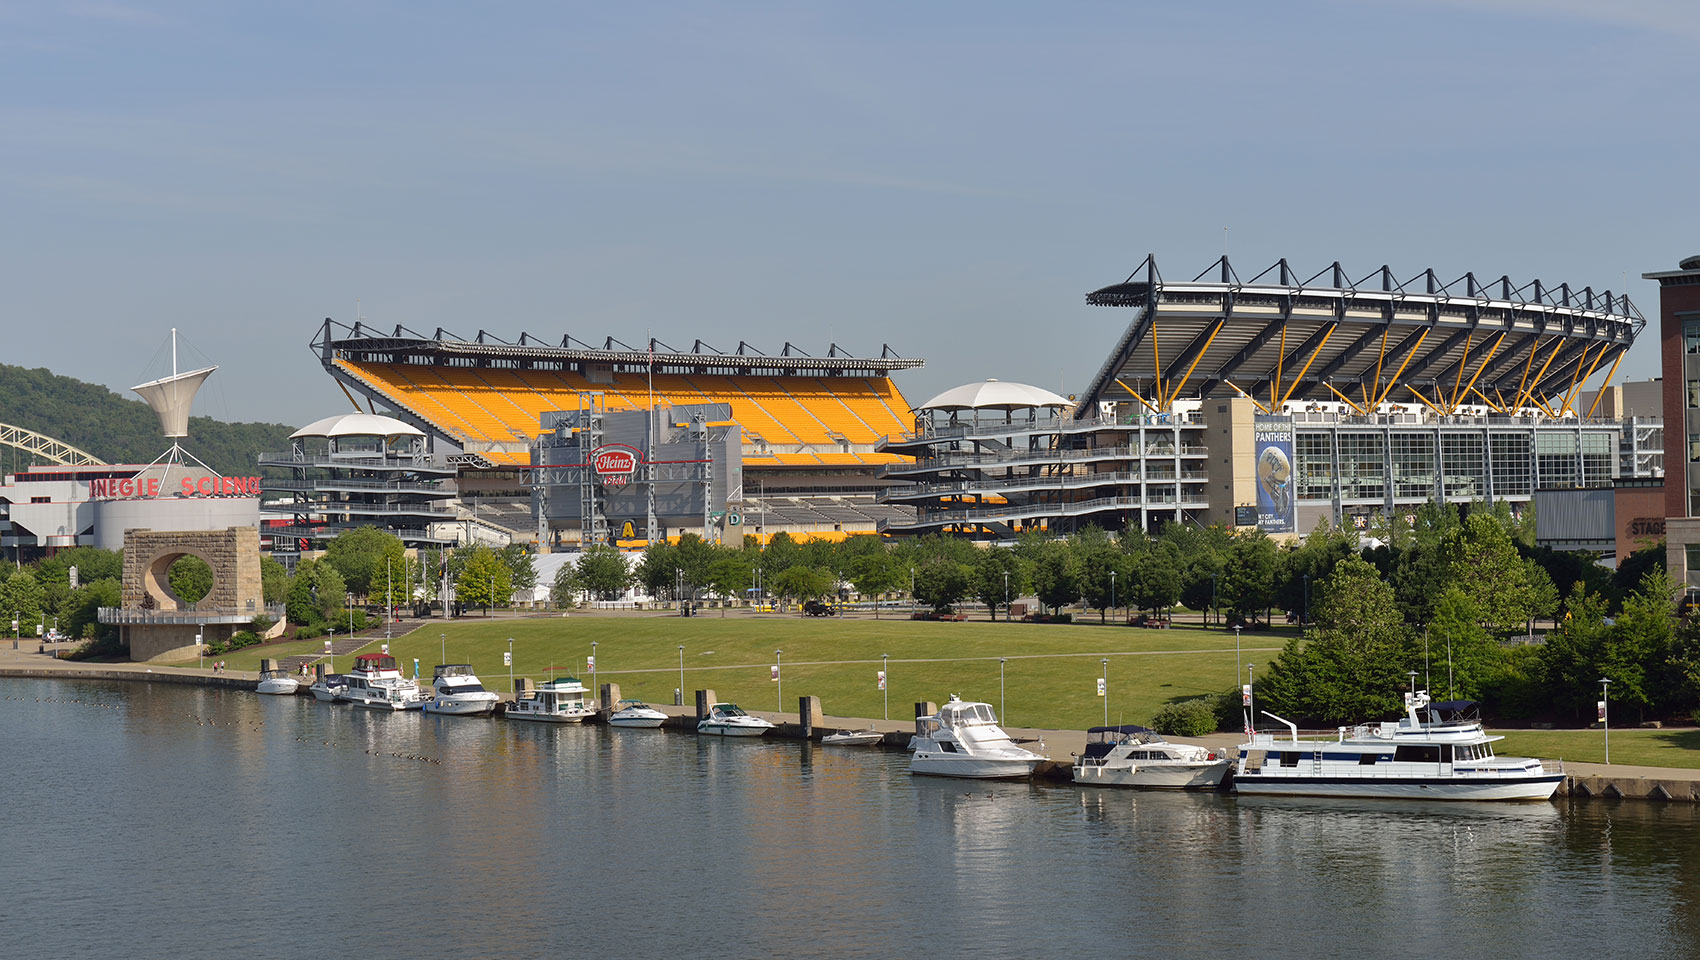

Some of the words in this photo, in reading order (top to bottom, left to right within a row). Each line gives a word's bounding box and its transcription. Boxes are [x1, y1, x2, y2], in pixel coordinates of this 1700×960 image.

[1256, 423, 1272, 431] HOME
[1273, 423, 1281, 431] OF
[1282, 423, 1291, 431] THE
[1256, 432, 1291, 442] PANTHERS
[598, 456, 631, 469] Heinz
[622, 522, 635, 538] A
[1632, 522, 1666, 535] STAGE
